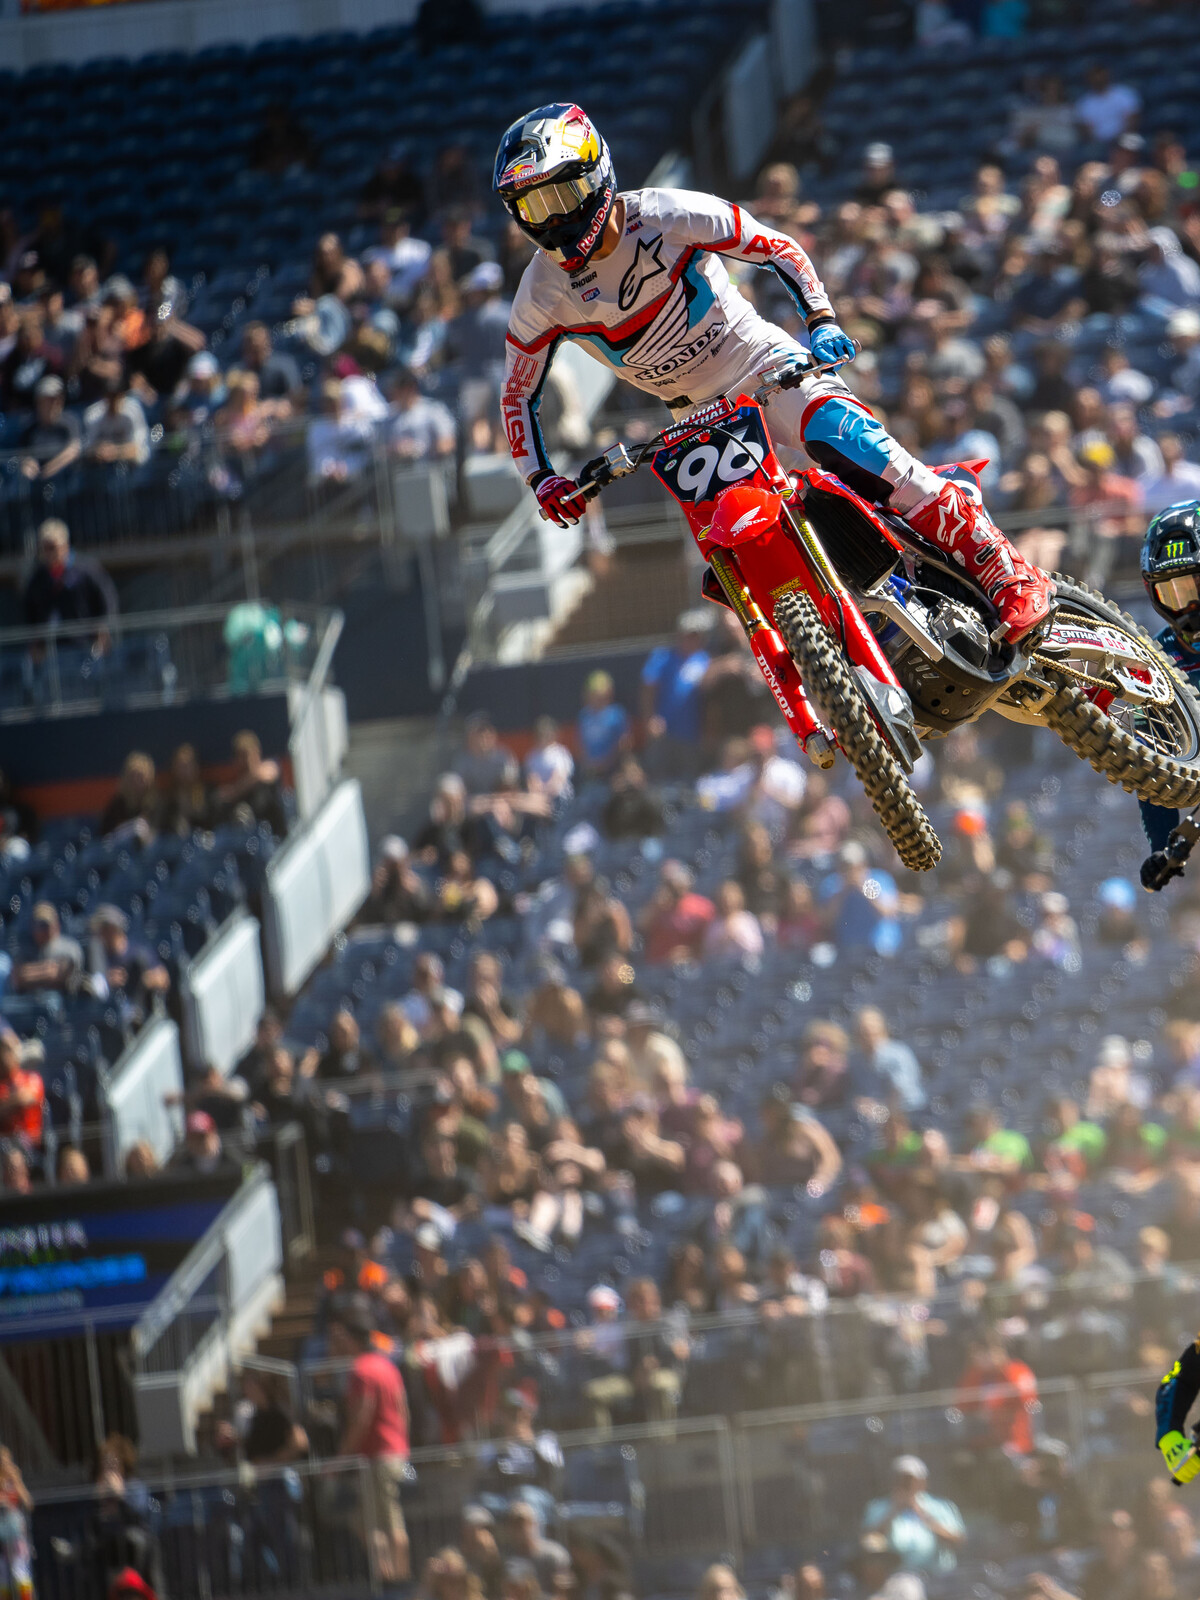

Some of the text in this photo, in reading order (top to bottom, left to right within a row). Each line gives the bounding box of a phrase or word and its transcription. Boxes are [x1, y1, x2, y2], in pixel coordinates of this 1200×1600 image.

[576, 219, 601, 256] Red
[596, 187, 613, 226] Bull
[570, 271, 598, 290] SHOWA
[634, 321, 724, 380] HONDA
[677, 425, 764, 508] 96
[717, 480, 745, 497] HONDA
[732, 517, 768, 537] HONDA
[713, 560, 744, 613] Connection
[757, 655, 795, 719] DUNLOP
[1165, 1442, 1186, 1464] FLY
